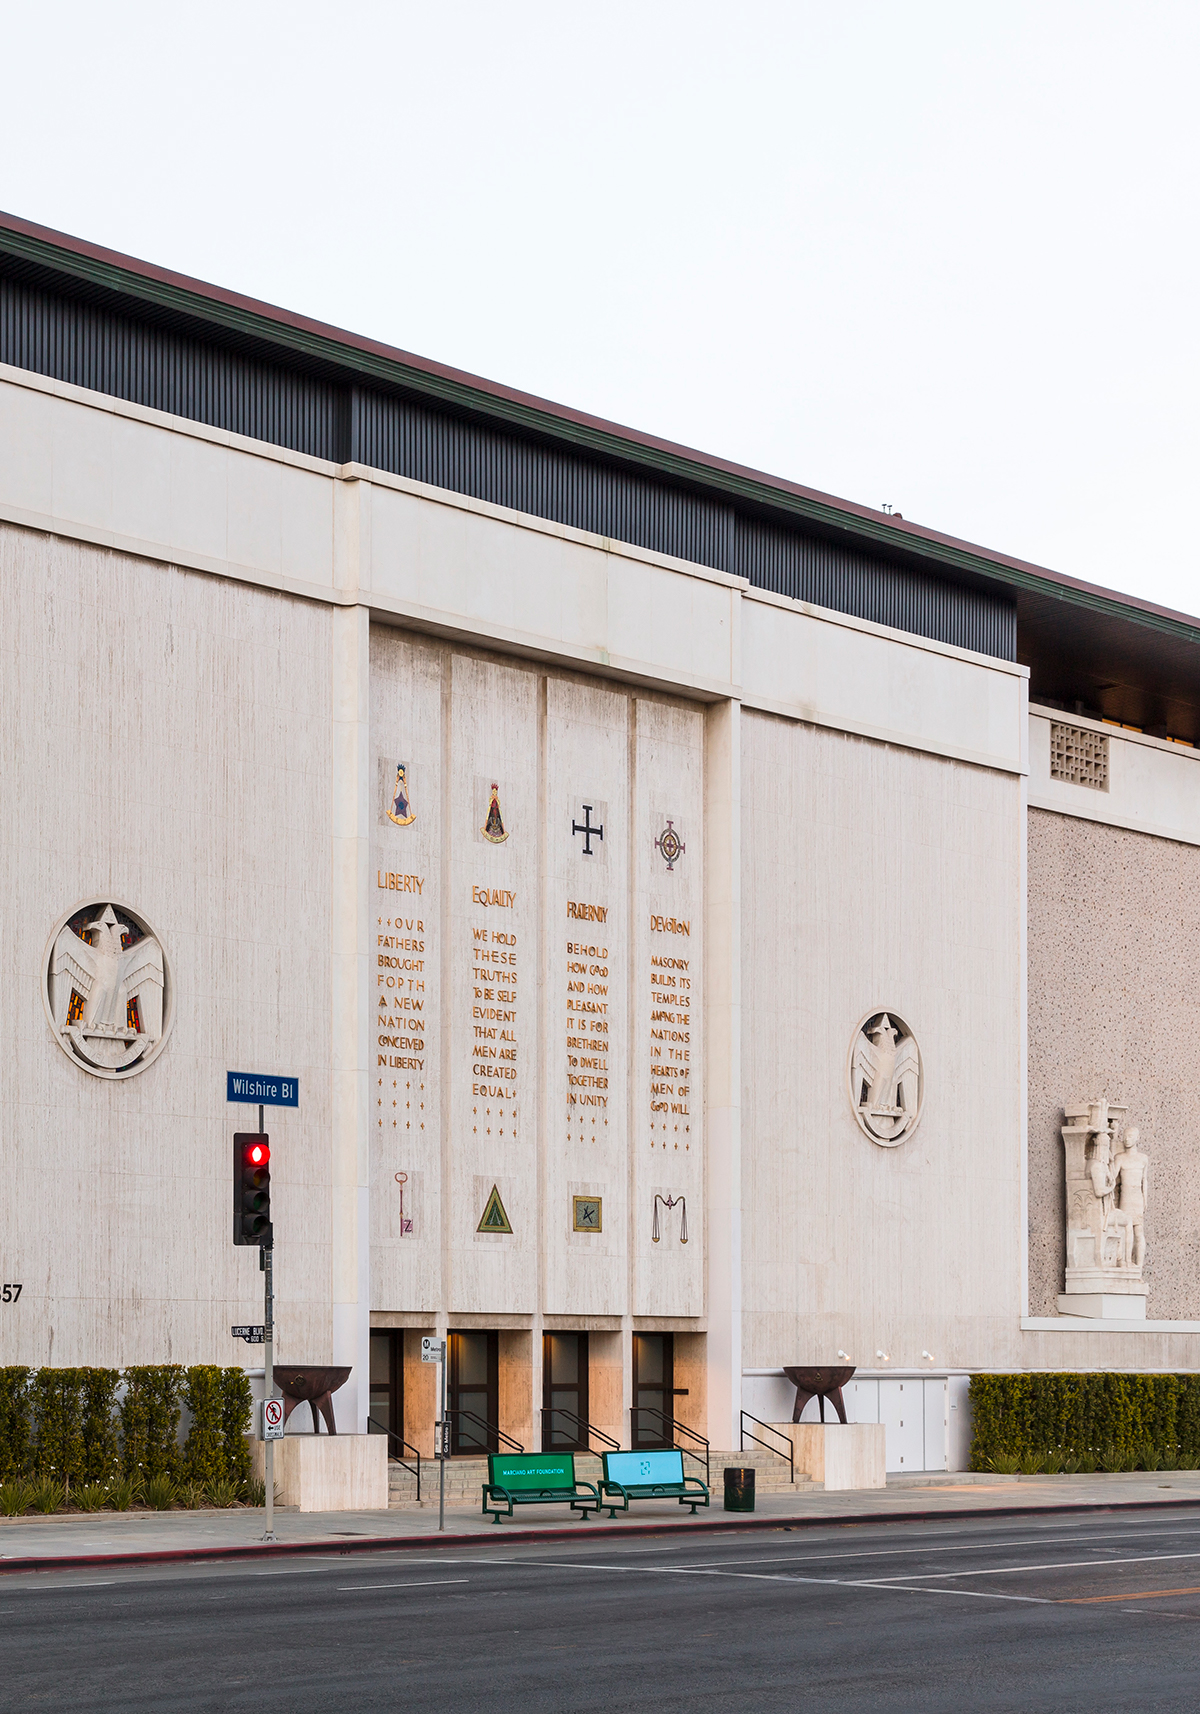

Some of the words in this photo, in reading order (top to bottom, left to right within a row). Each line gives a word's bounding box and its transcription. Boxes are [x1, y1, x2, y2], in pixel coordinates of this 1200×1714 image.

[377, 870, 425, 895] LIBERTY
[472, 885, 517, 909] EQUALITY
[567, 901, 609, 923] FRATERNITY
[394, 917, 425, 933] OUR
[651, 914, 690, 937] DEVOTION
[377, 935, 425, 953] FATHERS
[472, 928, 488, 942] WE
[491, 931, 517, 946] HOLD
[473, 948, 517, 965] THESE
[567, 942, 609, 959] BEHOLD
[377, 954, 425, 972] BROUGHT
[567, 961, 588, 975] HOW
[589, 964, 609, 978] GOOD
[650, 955, 690, 971] MASONRY
[472, 967, 517, 984] TRUTHS
[651, 973, 676, 988] BUILDS
[679, 977, 691, 989] ITS
[484, 988, 494, 1001] BE
[497, 990, 517, 1003] SELF
[567, 980, 586, 993] AND
[587, 983, 609, 996] HOW
[378, 995, 388, 1007] A
[394, 997, 425, 1011] NEW
[566, 999, 609, 1014] PLEASANT
[651, 991, 691, 1008] TEMPLES
[472, 1006, 517, 1022] EVIDENT
[650, 1010, 675, 1024] AMONG
[676, 1013, 690, 1026] THE
[377, 1015, 425, 1031] NATION
[567, 1017, 575, 1029] IT
[578, 1019, 586, 1031] IS
[590, 1020, 609, 1033] FOR
[473, 1026, 498, 1040] THAT
[499, 1029, 517, 1042] ALL
[650, 1028, 690, 1043] NATIONS
[377, 1035, 425, 1051] CONCEIVED
[566, 1036, 609, 1052] BRETHREN
[472, 1045, 497, 1059] MEN
[499, 1048, 517, 1061] ARE
[650, 1046, 662, 1057] IN
[668, 1048, 690, 1061] THE
[377, 1054, 387, 1066] IN
[389, 1055, 425, 1071] LIBERTY
[580, 1056, 609, 1071] DWELL
[472, 1064, 517, 1080] CREATED
[650, 1064, 679, 1078] HEARTS
[232, 1078, 278, 1098] Wilshire
[281, 1082, 293, 1099] Bl
[567, 1073, 609, 1089] TOGETHER
[472, 1083, 512, 1099] EQUAL
[650, 1082, 674, 1095] MEN
[678, 1086, 690, 1097] OF
[567, 1092, 577, 1105] IN
[579, 1094, 609, 1108] UNITY
[670, 1102, 690, 1115] WILL
